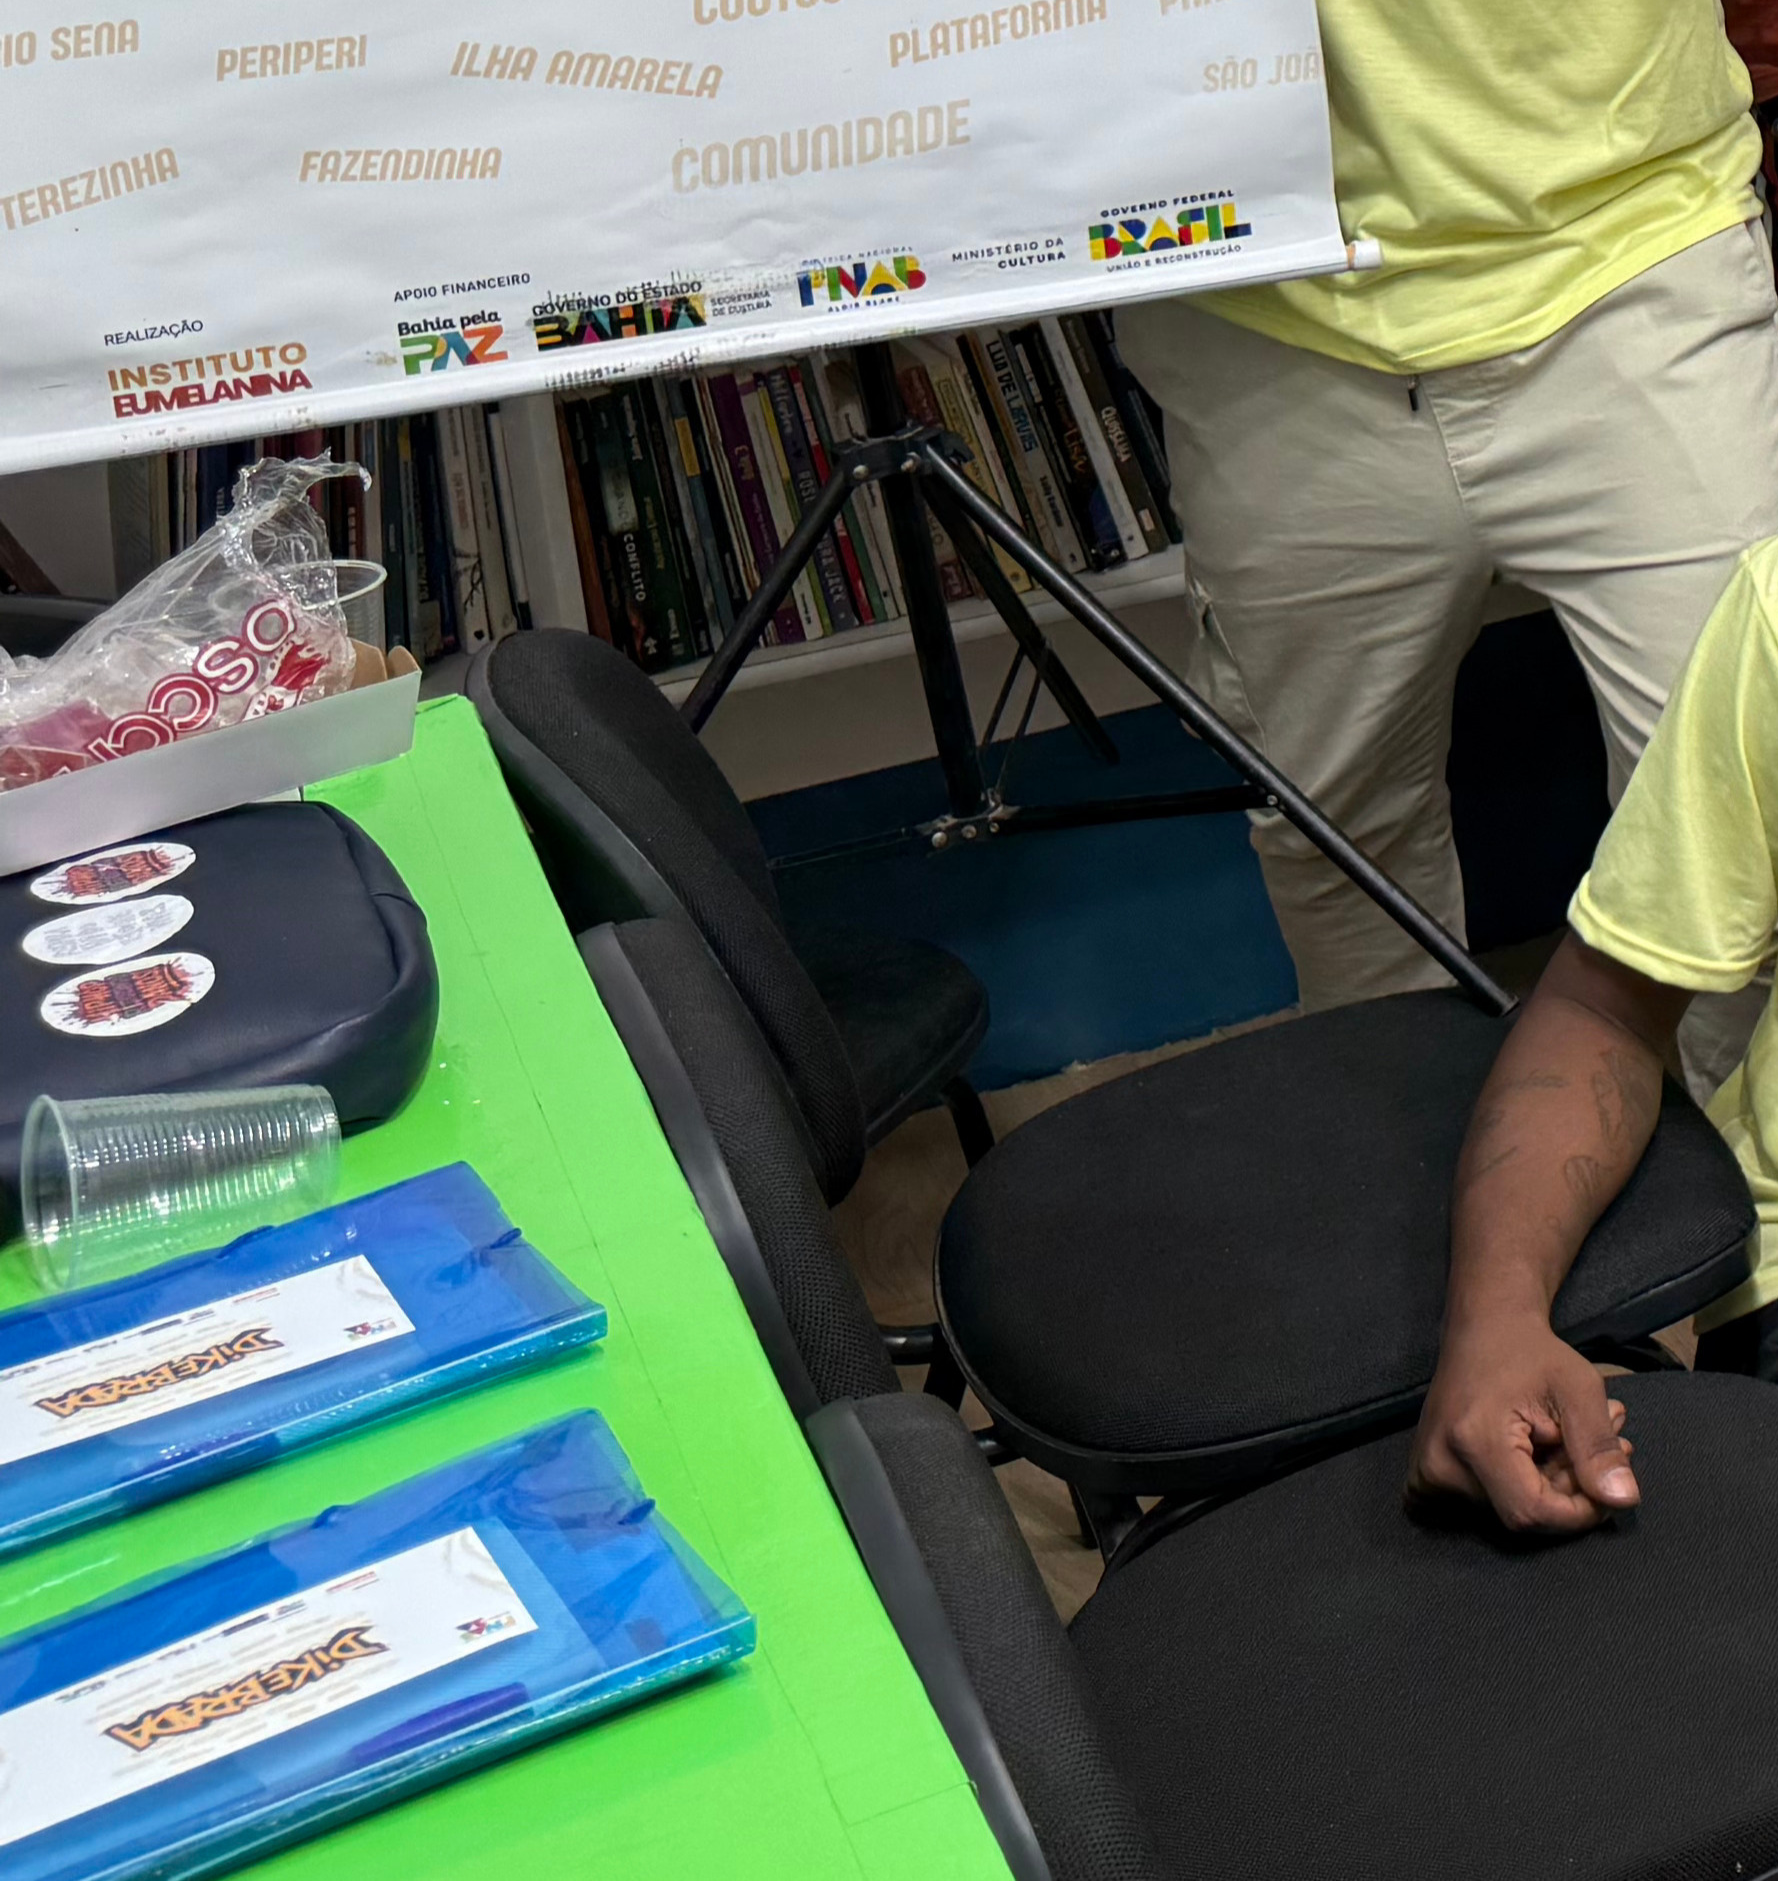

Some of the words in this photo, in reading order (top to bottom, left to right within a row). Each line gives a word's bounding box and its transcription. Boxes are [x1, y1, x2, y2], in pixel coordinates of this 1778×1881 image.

[51, 20, 139, 61] SENA
[216, 35, 366, 82] PERIPERI
[450, 42, 537, 82] ILHA
[546, 50, 723, 99] AMARELA
[1203, 52, 1258, 93] SÃO
[300, 147, 501, 183] FAZENDINHA
[672, 98, 971, 194] COMUNIDADE
[1, 147, 179, 229] TEREZINHA
[1100, 199, 1167, 218] GOVERNO
[1173, 189, 1234, 206] FEDERAL
[952, 241, 1039, 262] MINISTÉRIO
[1046, 237, 1064, 248] DA
[1088, 202, 1252, 261] BRASIL
[797, 255, 927, 307] PNAB
[997, 251, 1066, 269] CULTURA
[394, 286, 437, 302] APOIO
[441, 273, 531, 296] FINANCEIRO
[532, 294, 611, 317] GOVERNO
[615, 291, 638, 304] DO
[643, 281, 702, 300] ESTADO
[104, 320, 203, 346] REALIZAÇÃO
[397, 317, 454, 335] Bahia
[460, 310, 501, 332] pela
[533, 294, 707, 351] BAHIA
[109, 341, 308, 392] INSTITUTO
[400, 325, 508, 375] PAZ
[113, 368, 312, 417] EUMELANINA
[998, 370, 1016, 394] DE
[1007, 395, 1038, 452] LARVAS
[624, 533, 646, 602] CONFLITO
